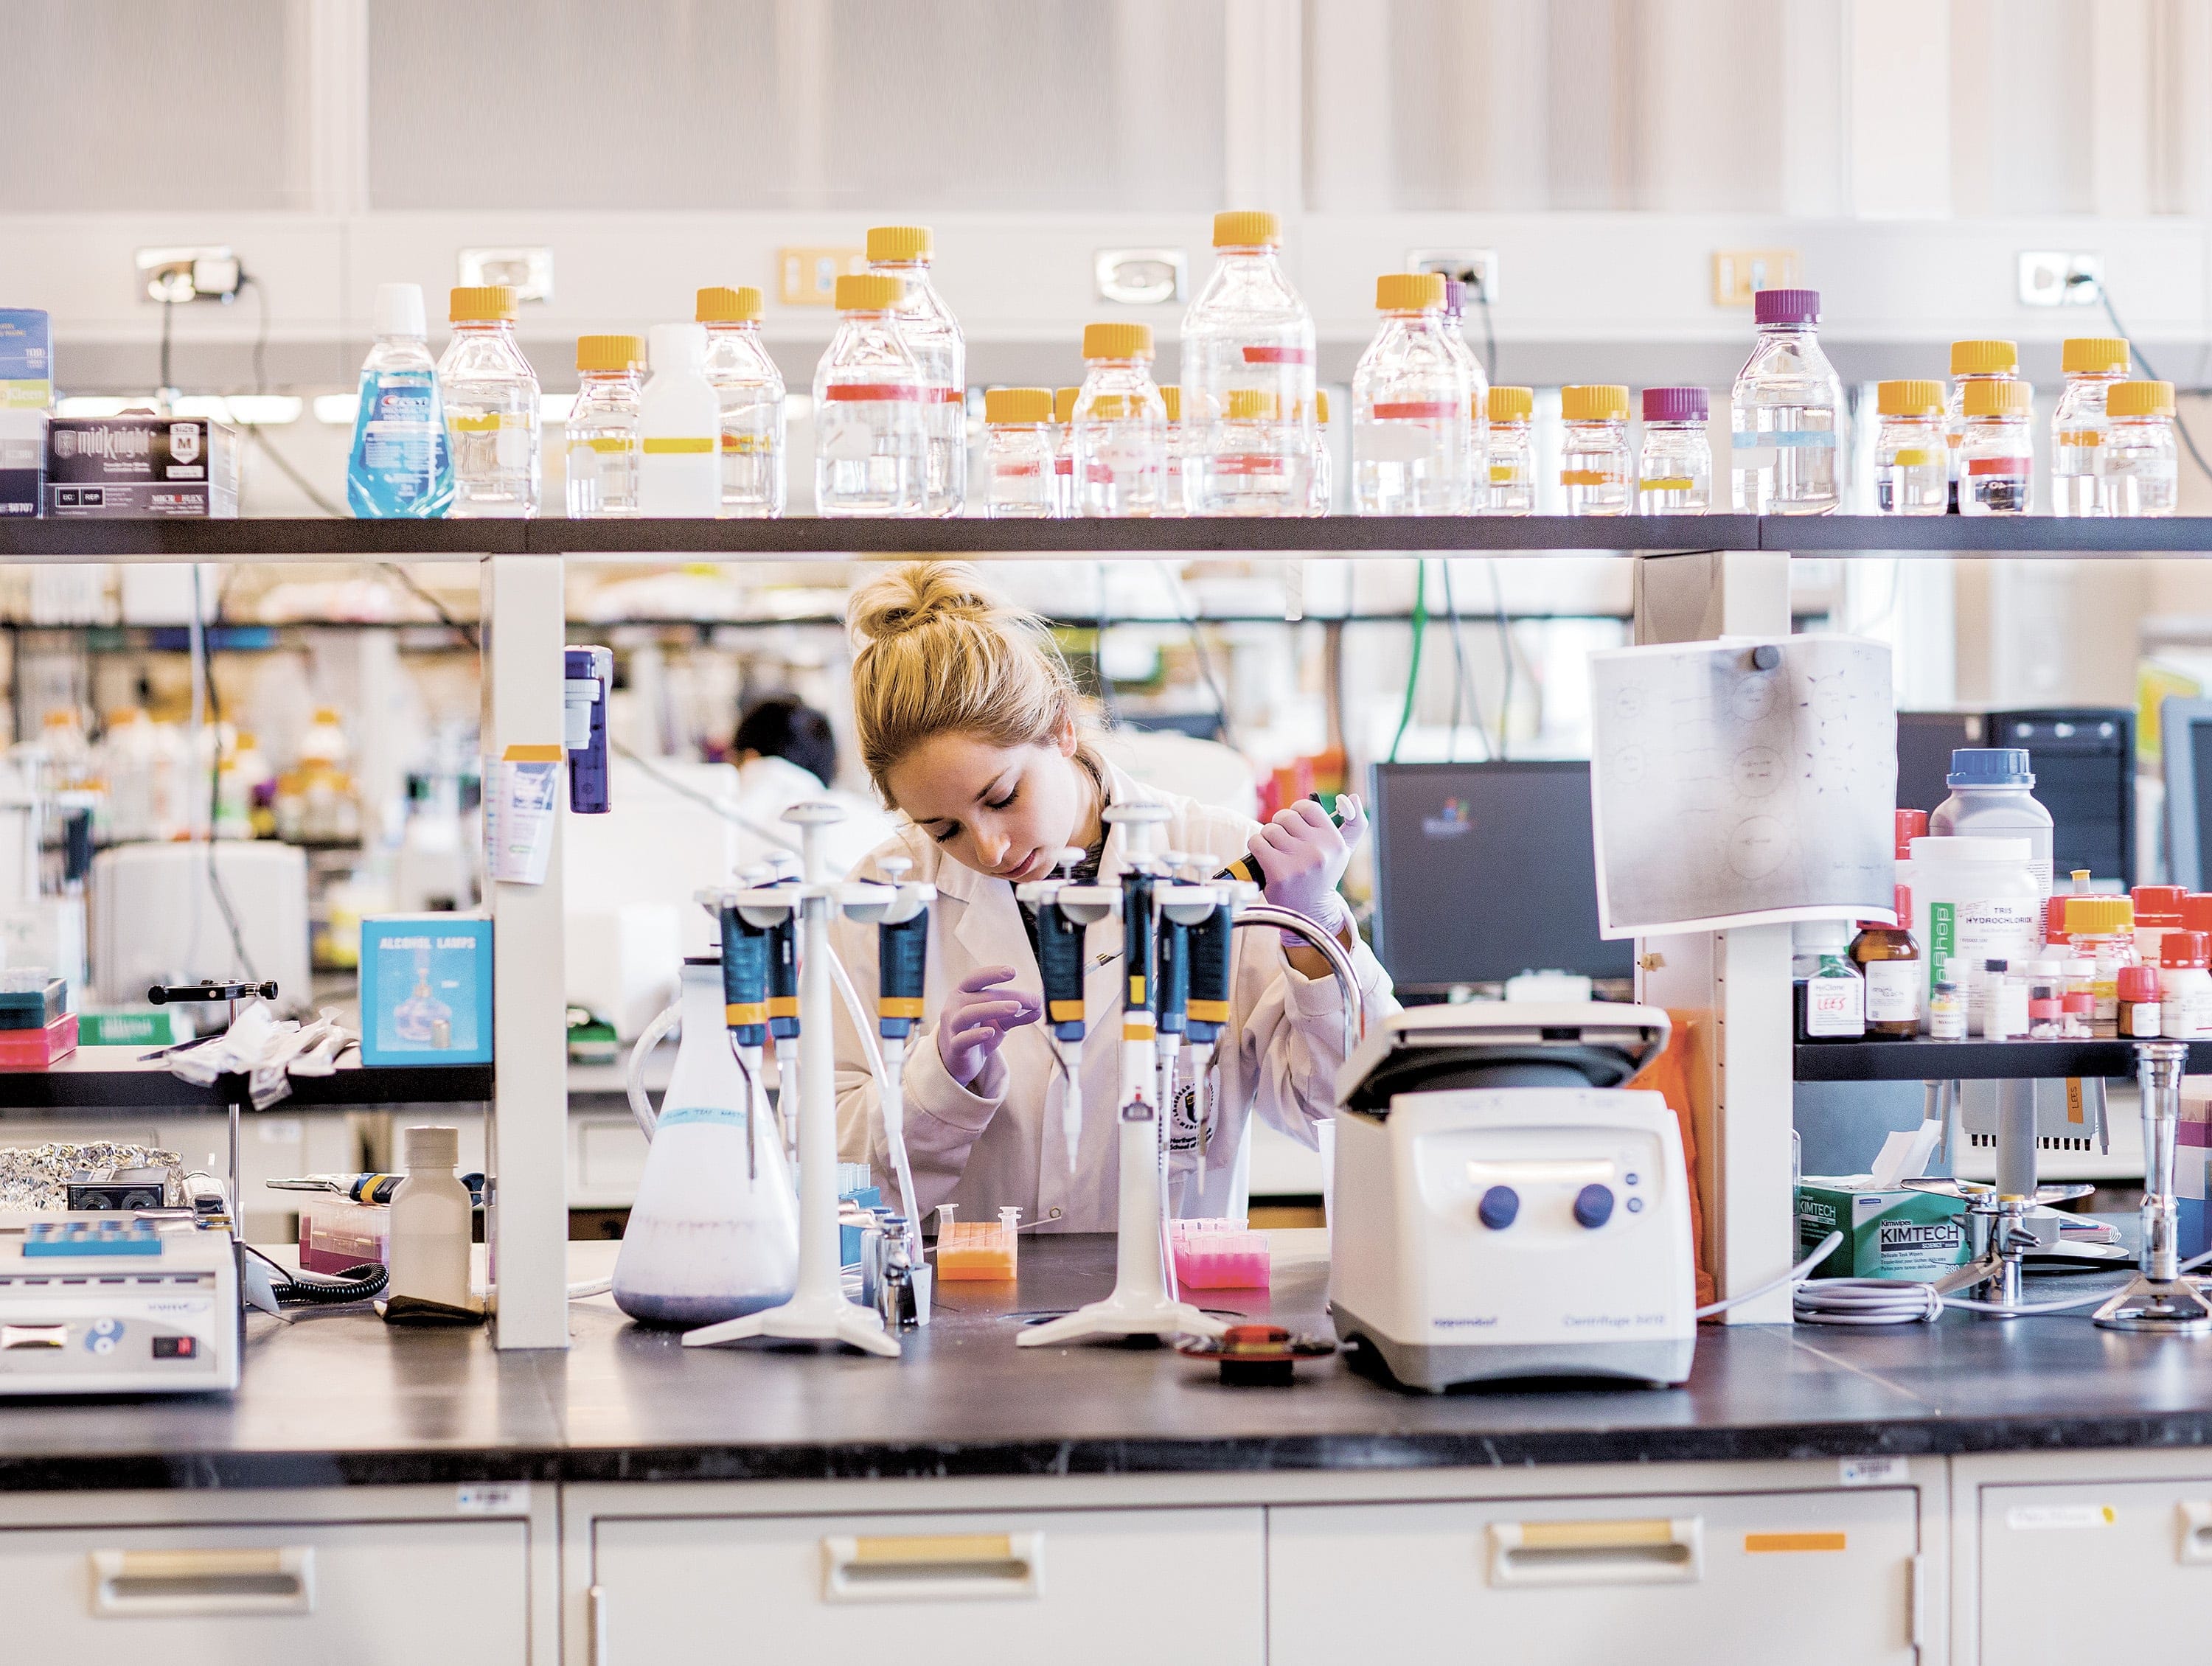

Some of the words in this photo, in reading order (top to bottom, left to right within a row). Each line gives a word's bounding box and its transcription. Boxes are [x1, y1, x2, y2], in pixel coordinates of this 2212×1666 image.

[178, 438, 191, 448] M
[2070, 1086, 2079, 1109] LEES
[1800, 1200, 1837, 1219] KIMTECH
[1881, 1219, 1912, 1227] Kimwipes
[1881, 1225, 1959, 1243] KIMTECH
[1945, 1264, 1960, 1275] 280
